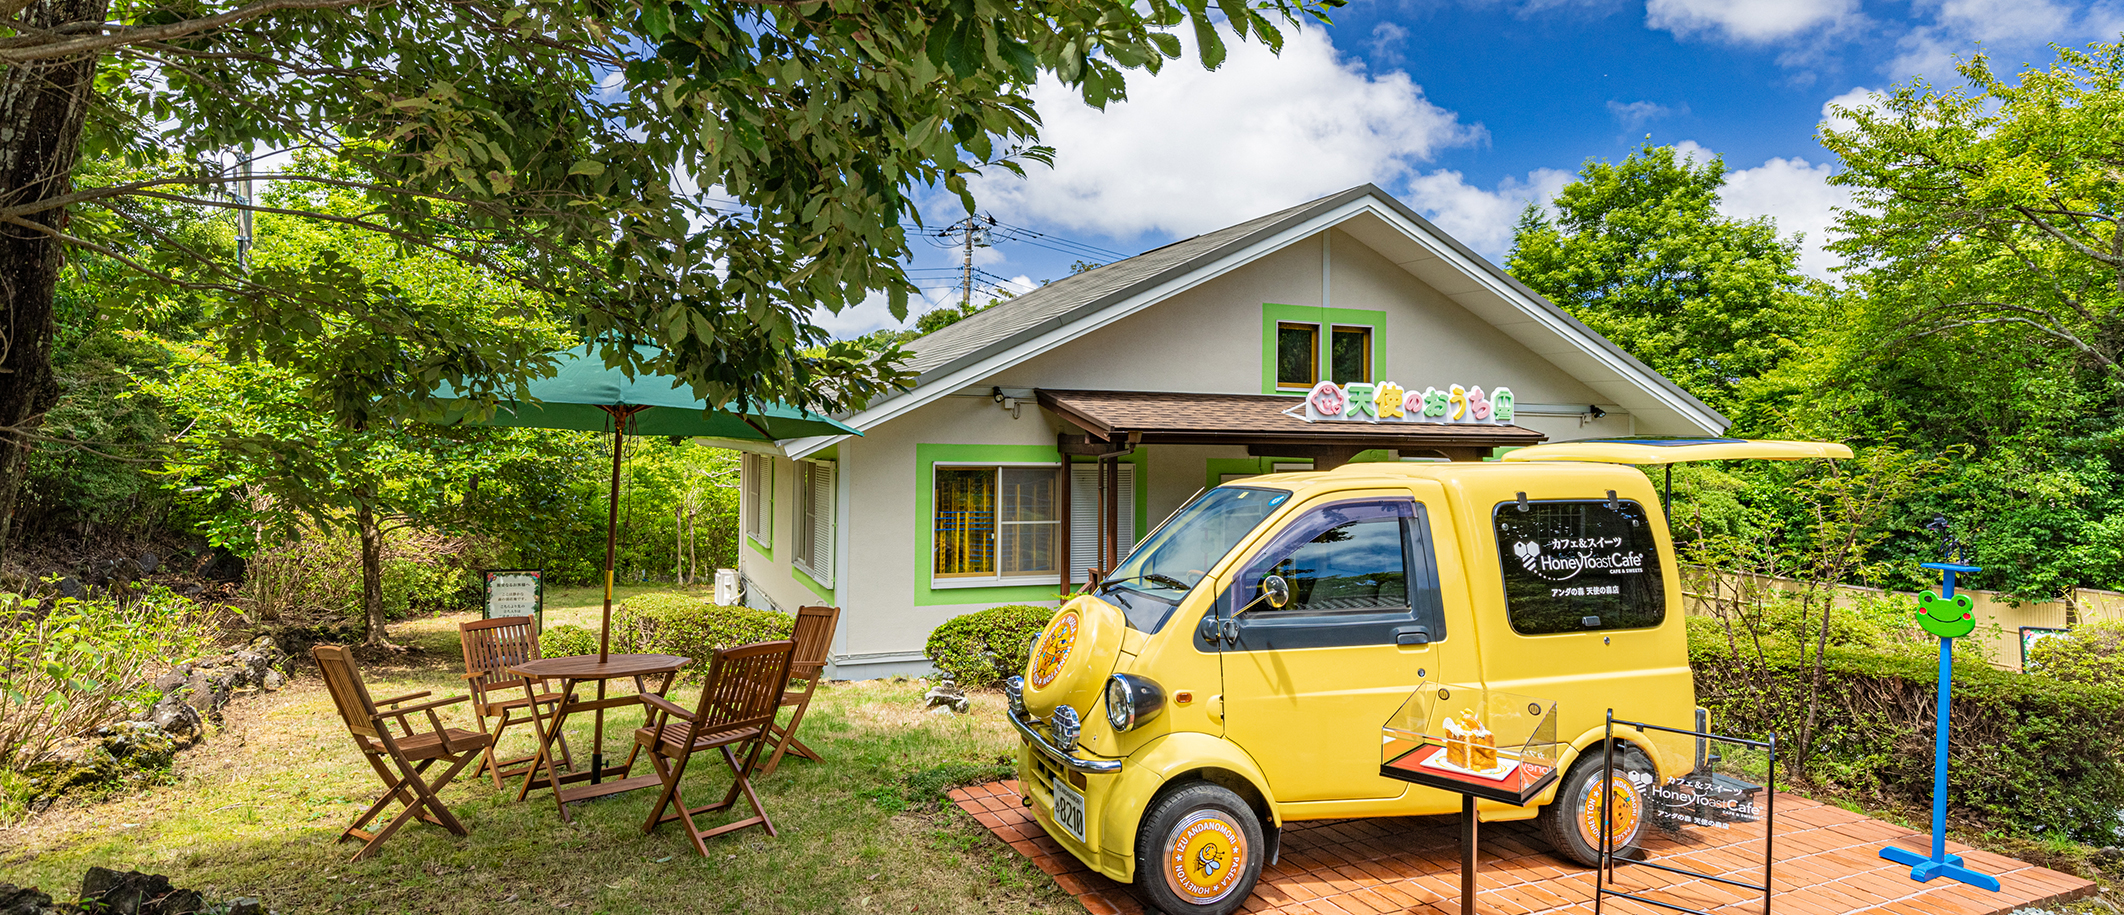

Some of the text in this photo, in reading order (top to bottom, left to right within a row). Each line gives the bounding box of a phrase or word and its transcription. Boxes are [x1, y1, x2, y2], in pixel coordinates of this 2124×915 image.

[1347, 385, 1490, 420] 天使のおうち
[1552, 536, 1622, 550] カフェ&スイーツ
[1666, 775, 1743, 796] カフェ&スイーツ
[1176, 822, 1237, 853] IZU ANDANOMORI
[1175, 864, 1210, 894] HONEYTON
[1220, 856, 1239, 887] PASELA
